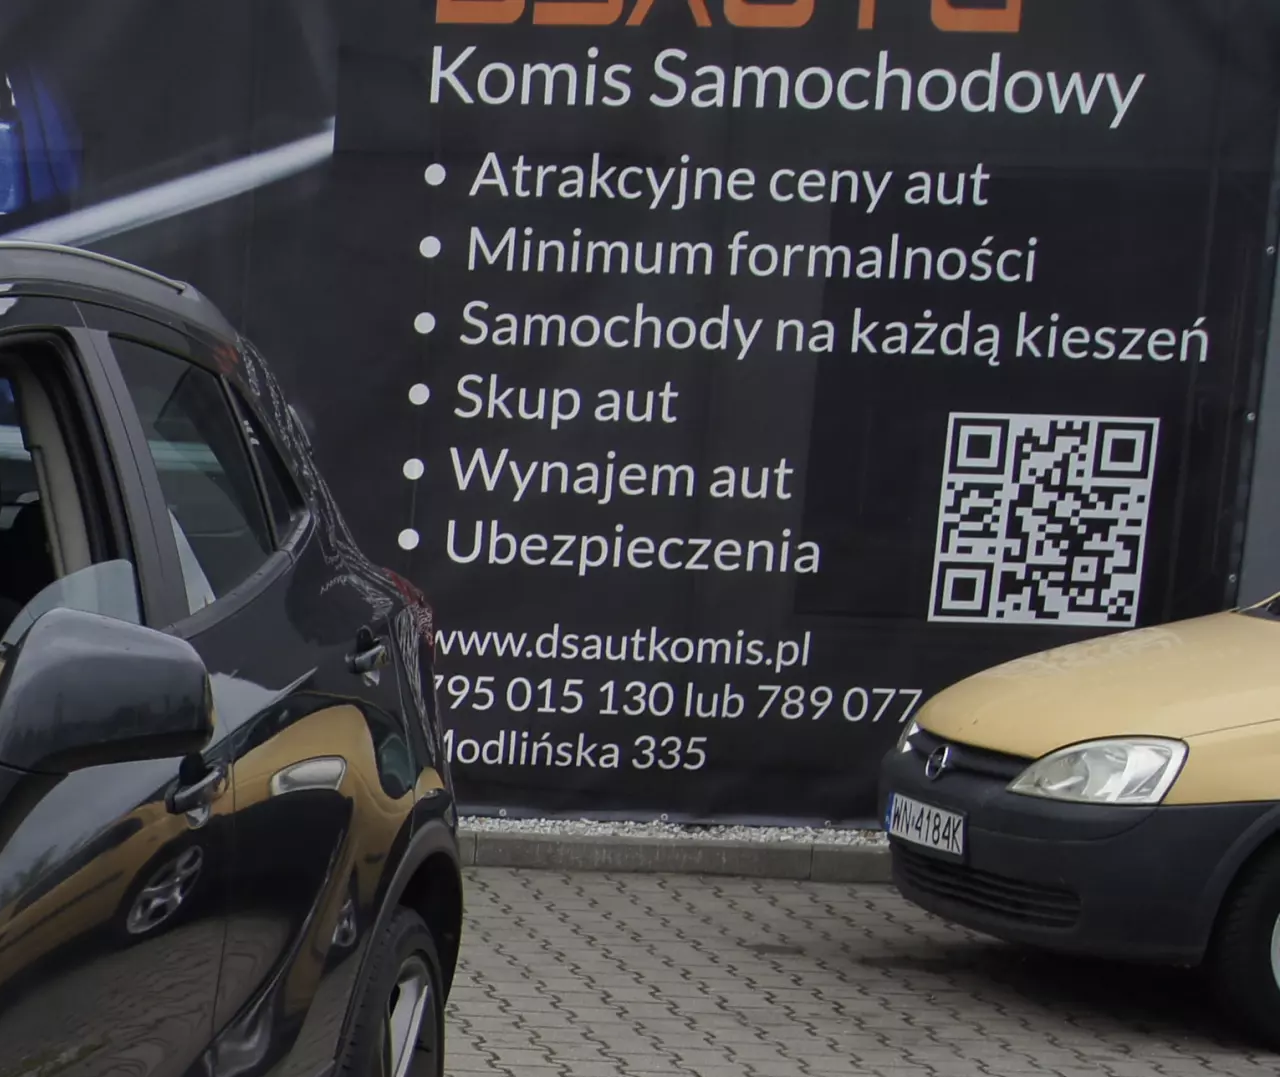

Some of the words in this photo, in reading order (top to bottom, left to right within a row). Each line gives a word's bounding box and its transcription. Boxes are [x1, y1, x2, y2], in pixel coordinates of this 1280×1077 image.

[429, 45, 633, 107] Komis
[649, 48, 1147, 129] Samochodowy
[469, 151, 756, 210] Atrakcyjne
[769, 166, 894, 214] ceny
[904, 162, 991, 206] aut
[467, 226, 714, 275] Minimum
[728, 230, 1039, 283] formalności
[459, 300, 764, 360] Samochody
[775, 317, 835, 354] na
[851, 307, 1002, 367] każdą
[1014, 311, 1210, 363] kieszeń
[453, 373, 582, 430] Skup
[594, 381, 679, 424] aut
[449, 446, 696, 505] Wynajem
[709, 458, 795, 501] aut
[445, 519, 822, 577] Ubezpieczenia
[506, 677, 585, 714] 015
[598, 681, 675, 717] 130
[684, 682, 745, 719] lub
[756, 684, 834, 720] 789
[842, 686, 923, 723] 077
[631, 736, 708, 771] 335
[892, 797, 913, 836] WN
[914, 806, 962, 853] 4184K
